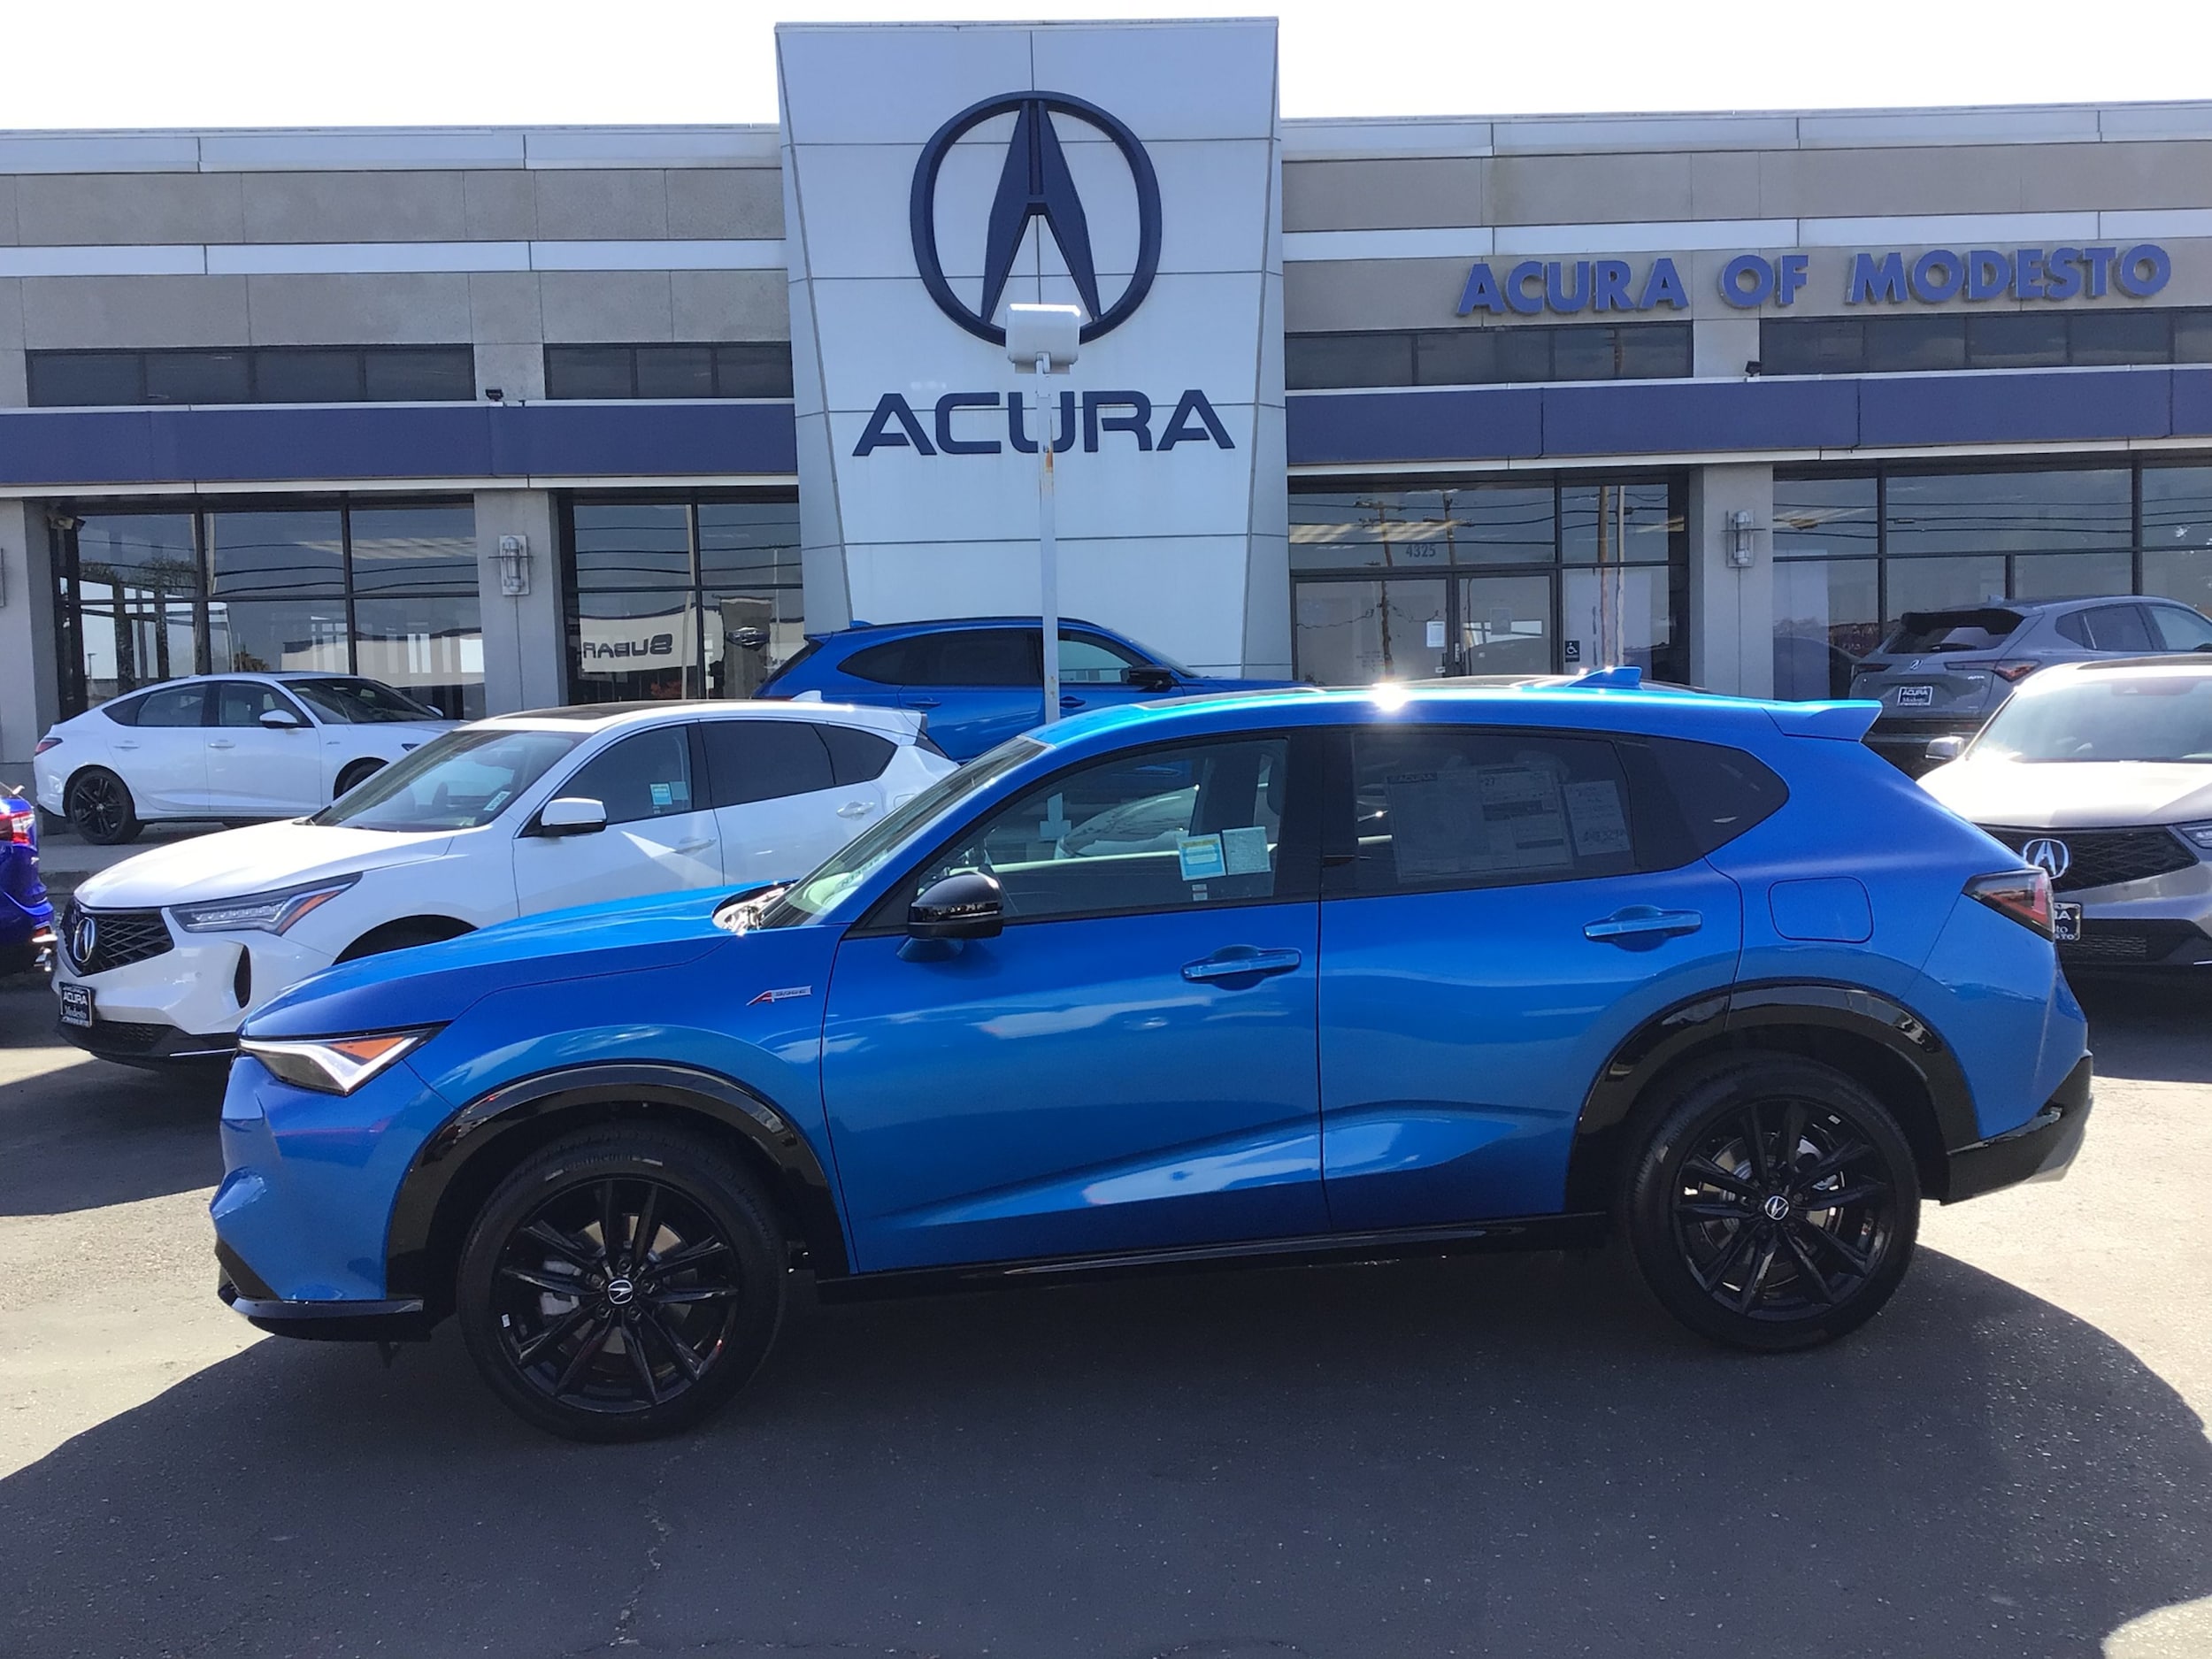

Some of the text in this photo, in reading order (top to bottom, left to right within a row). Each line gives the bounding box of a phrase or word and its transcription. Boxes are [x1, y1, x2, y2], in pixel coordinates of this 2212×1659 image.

[1456, 243, 2171, 315] ACURA OF MODESTO
[852, 389, 1235, 457] ACURA
[1405, 543, 1436, 557] 4325
[63, 990, 88, 1006] ACURA
